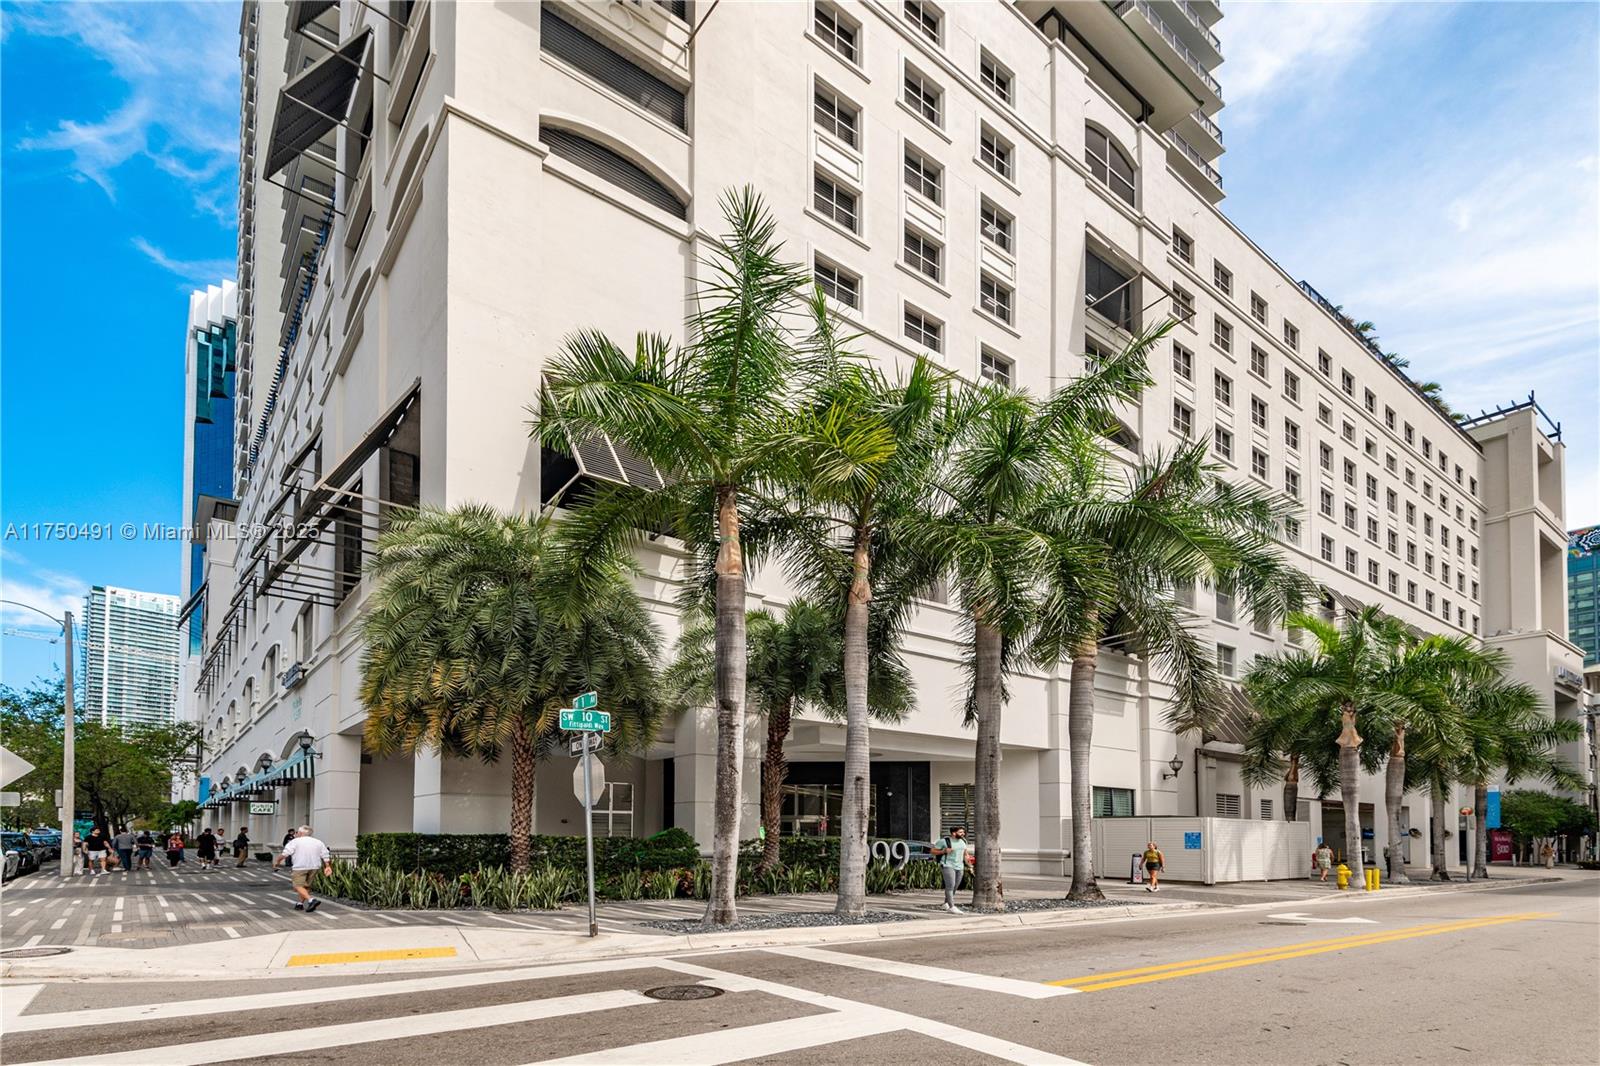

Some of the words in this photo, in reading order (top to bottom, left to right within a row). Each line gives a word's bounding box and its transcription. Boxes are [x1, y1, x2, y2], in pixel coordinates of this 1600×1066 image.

[562, 712, 574, 721] SW
[582, 712, 593, 722] 10
[600, 715, 608, 724] ST
[865, 841, 910, 870] 99
